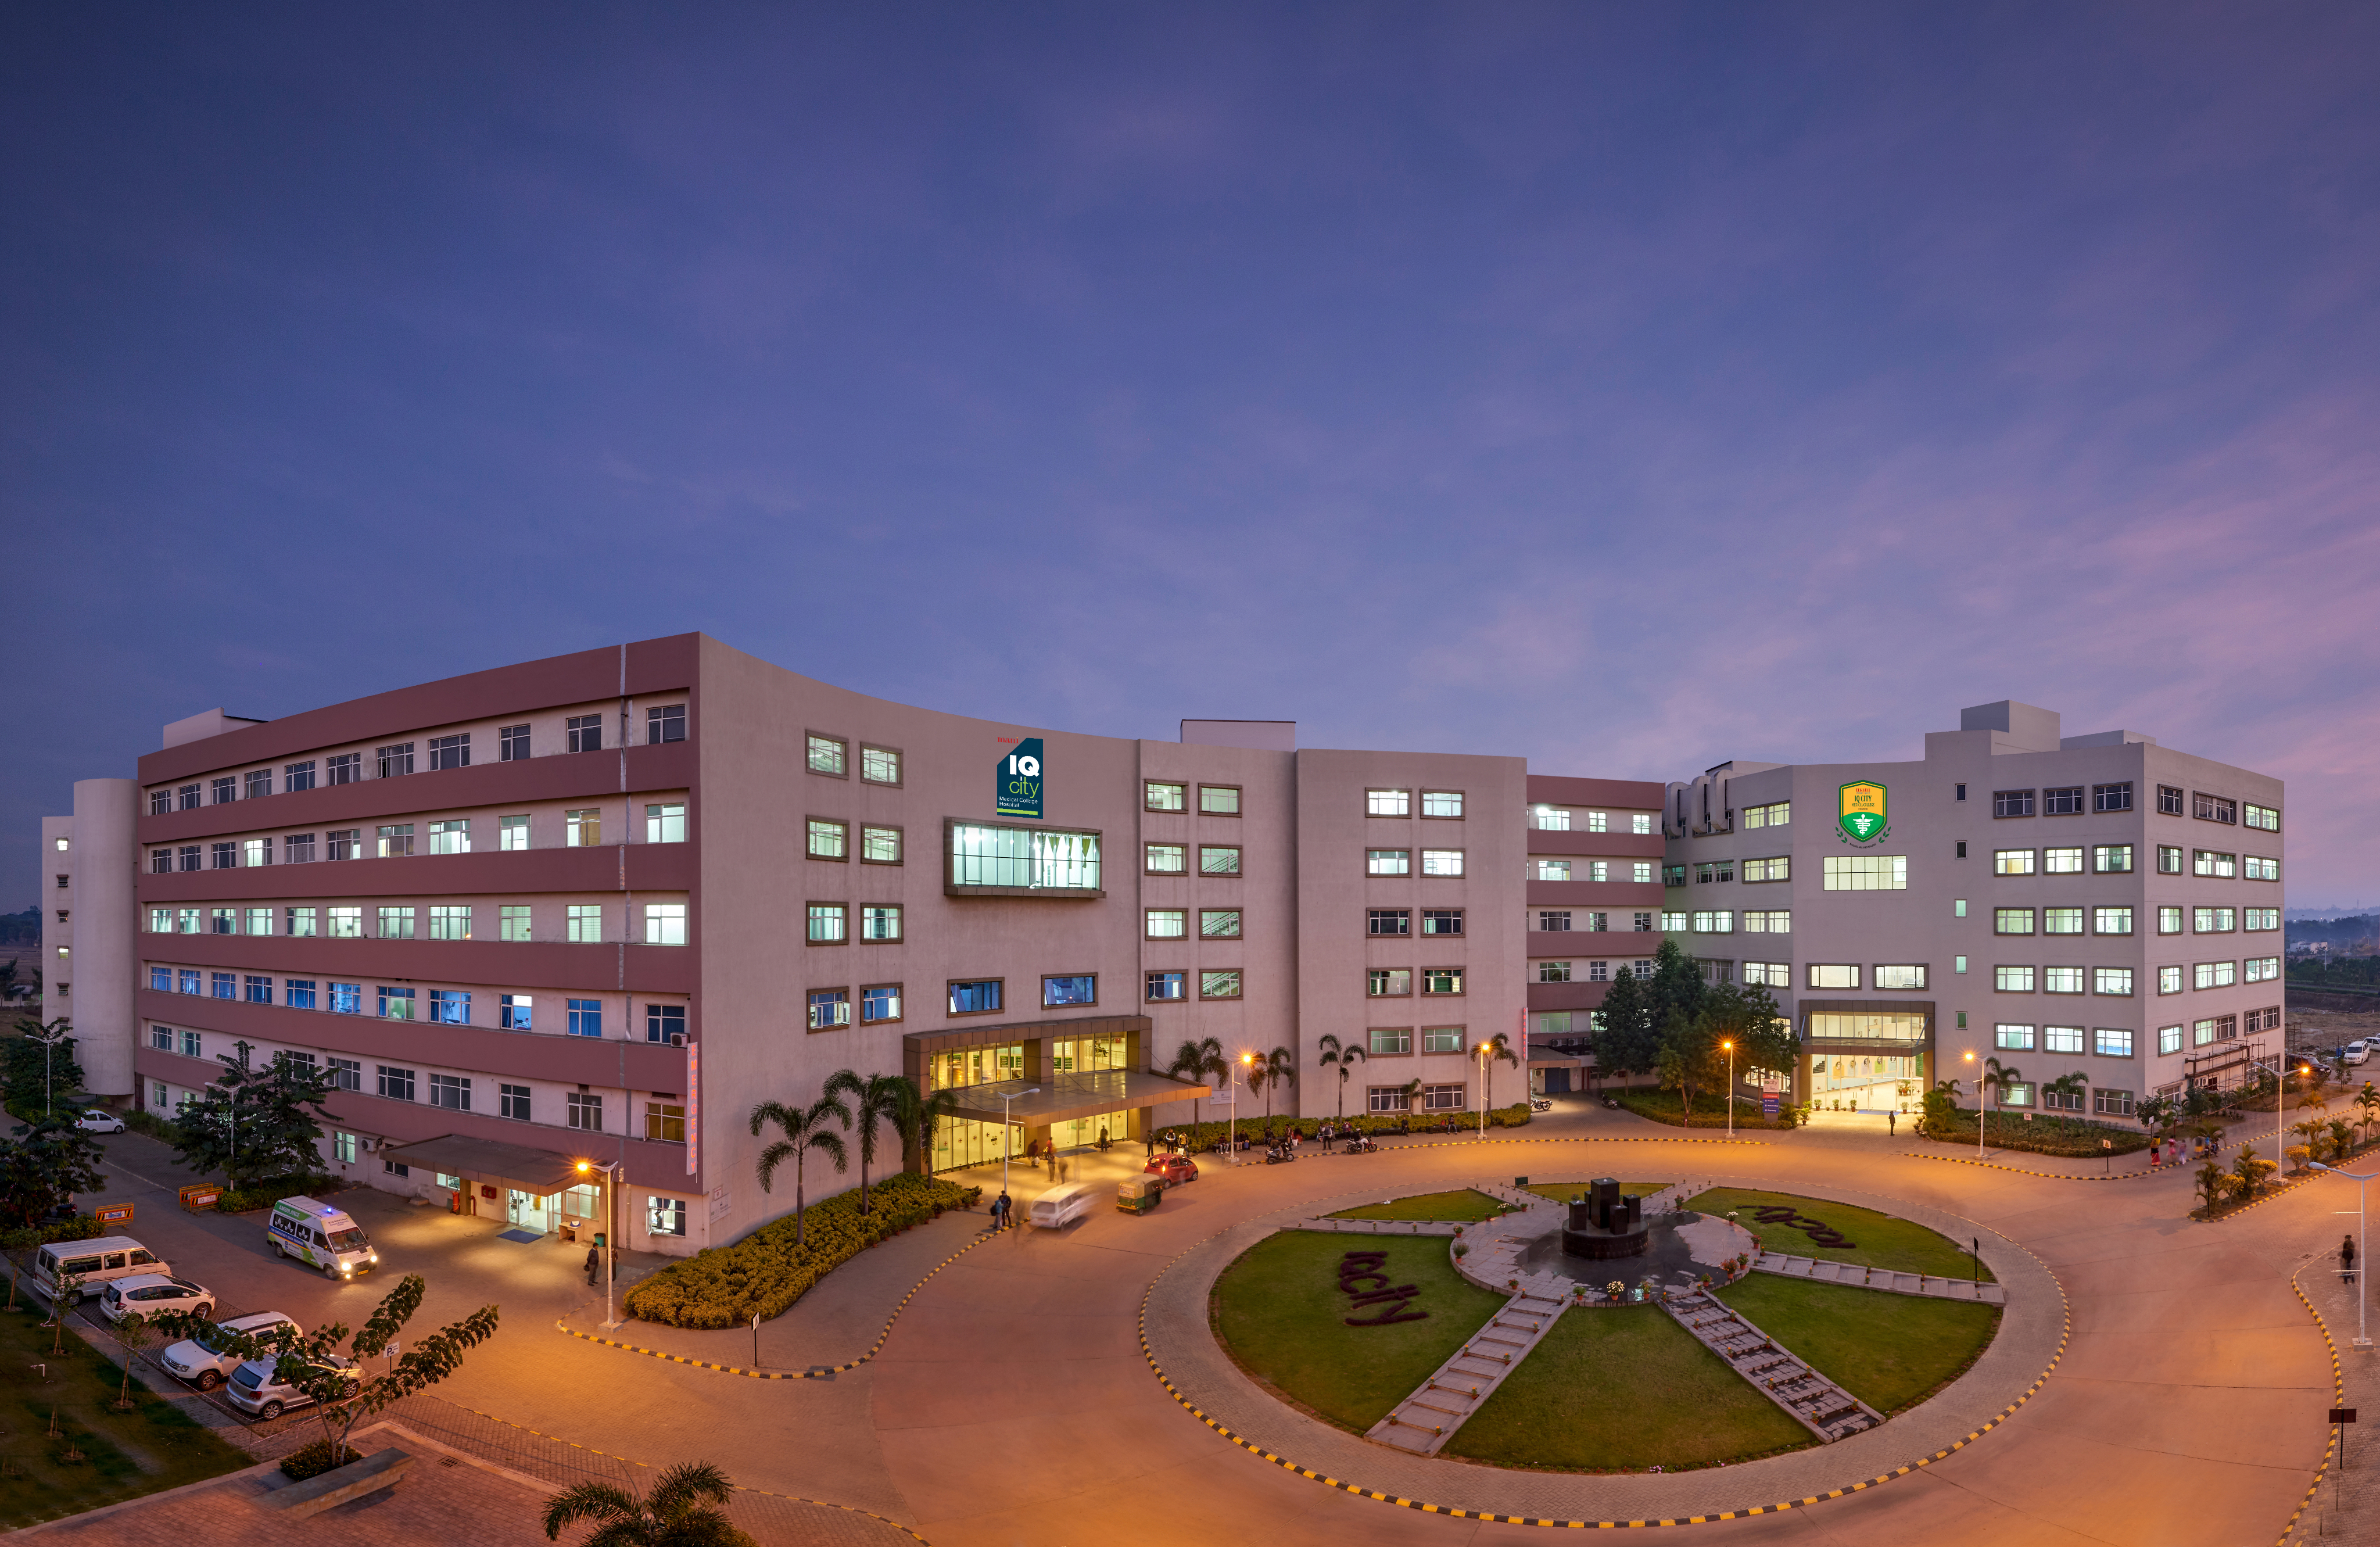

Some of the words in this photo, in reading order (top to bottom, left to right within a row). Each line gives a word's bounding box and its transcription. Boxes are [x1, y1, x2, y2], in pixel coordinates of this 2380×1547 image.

[1010, 755, 1040, 777] IQ
[1009, 776, 1039, 798] city
[279, 1205, 300, 1218] AMBULANCE
[387, 1348, 392, 1356] P
